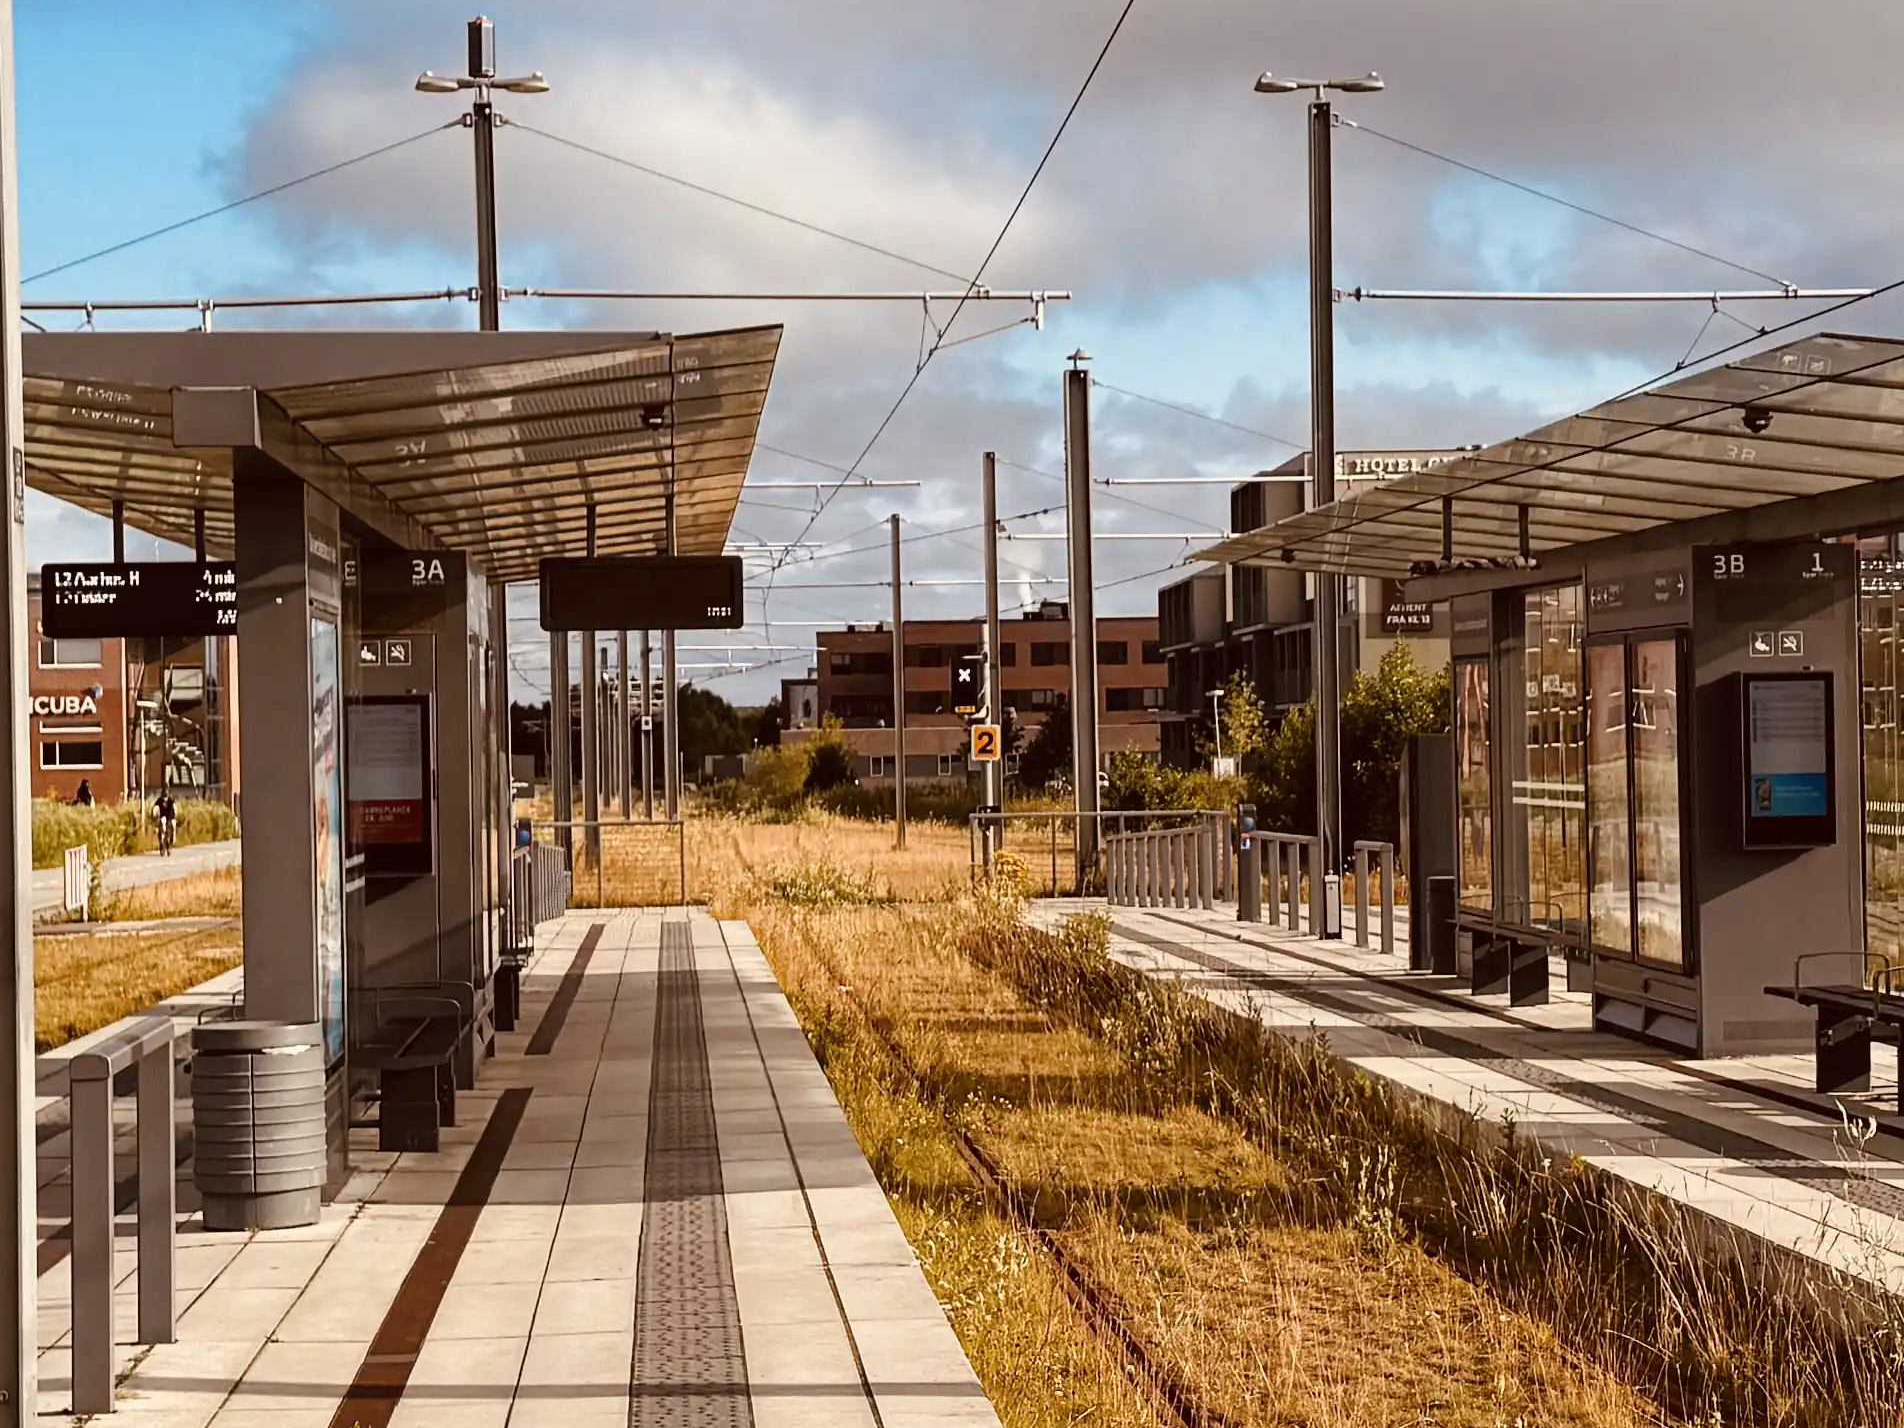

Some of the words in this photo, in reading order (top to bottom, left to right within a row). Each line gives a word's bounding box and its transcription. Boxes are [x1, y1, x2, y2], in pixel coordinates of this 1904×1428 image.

[1355, 458, 1421, 472] HOTEL
[412, 559, 445, 580] 3A
[1713, 554, 1745, 574] 3B
[1811, 552, 1824, 572] 1
[978, 732, 994, 753] 2
